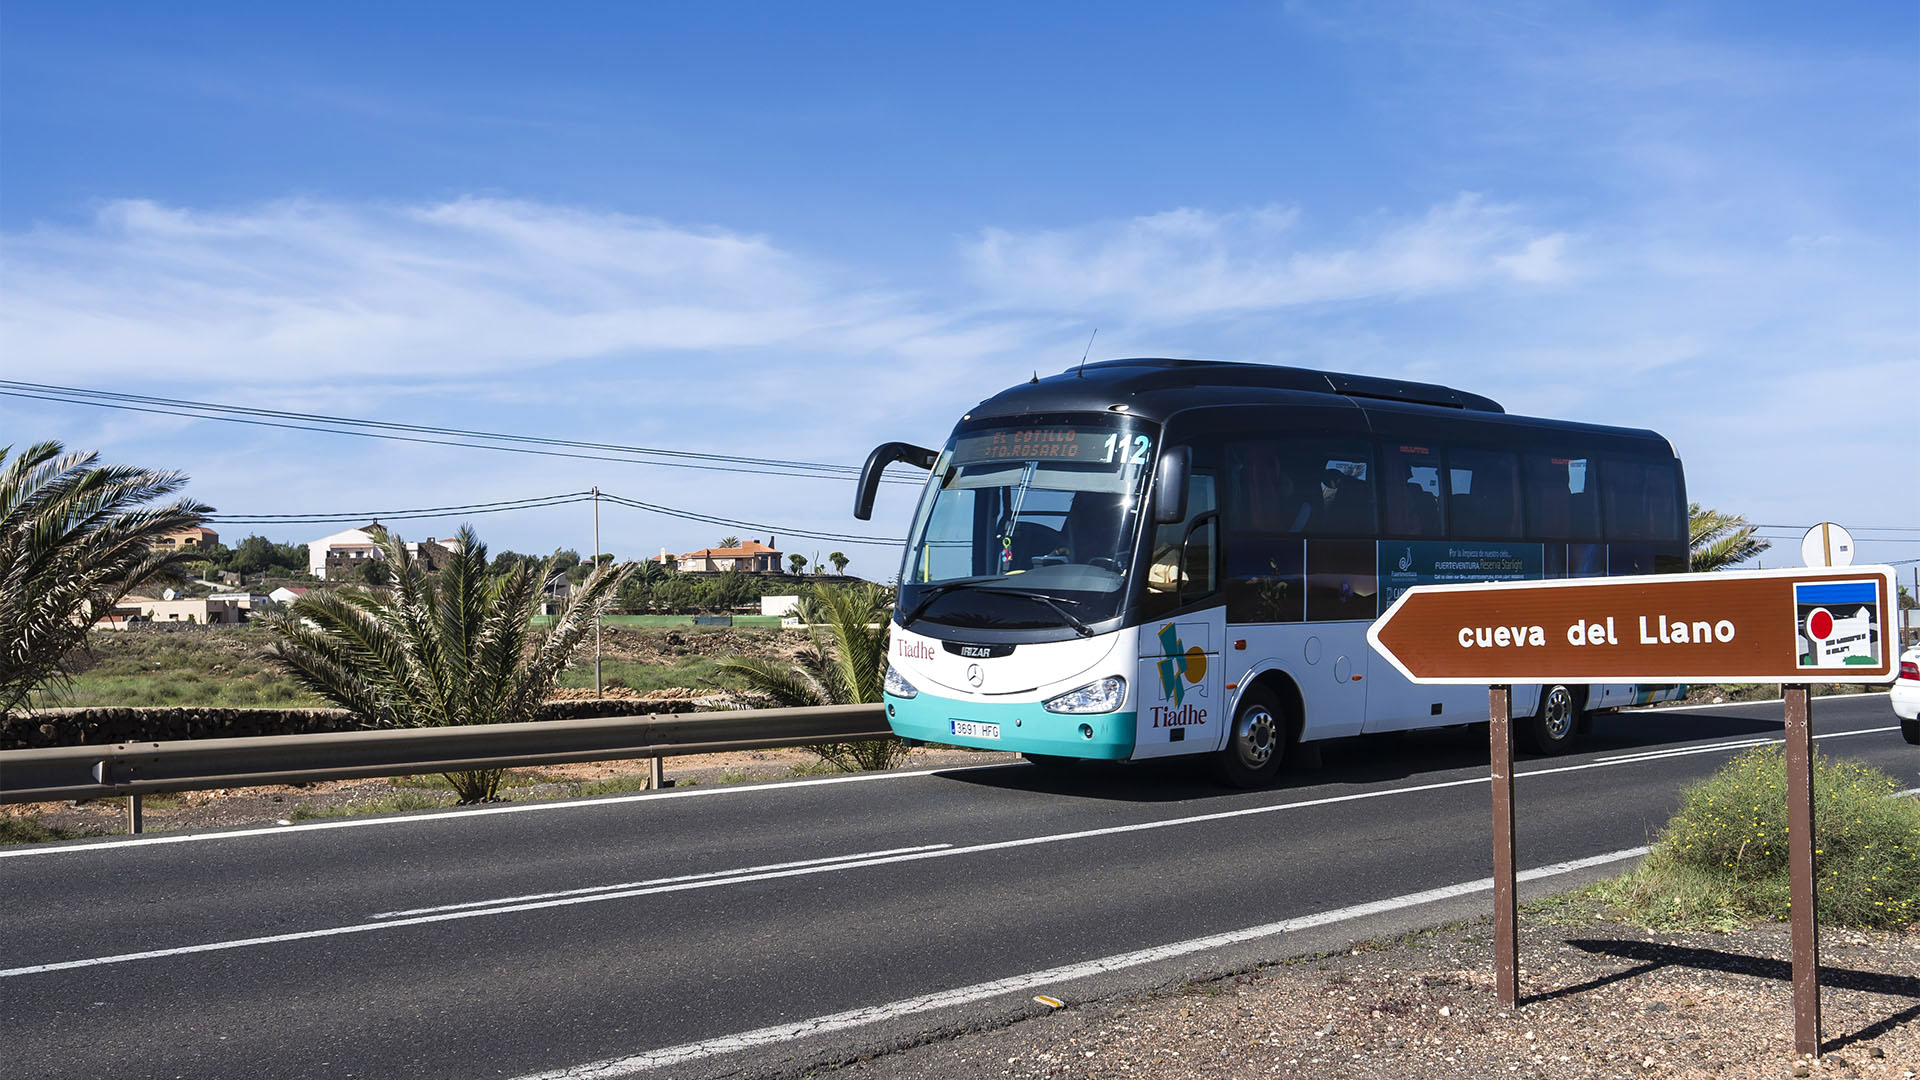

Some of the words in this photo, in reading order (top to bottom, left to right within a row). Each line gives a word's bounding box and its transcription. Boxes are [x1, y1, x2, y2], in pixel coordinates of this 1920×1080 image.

[993, 431, 1006, 444] EL
[1014, 429, 1076, 443] COTILLO
[1104, 433, 1149, 464] 112
[1458, 625, 1546, 648] cueva
[1567, 616, 1619, 646] del
[1639, 615, 1736, 645] Llano
[897, 639, 935, 660] Tiadhe
[961, 646, 990, 657] IRIZAR
[1150, 704, 1208, 728] Tiadhe
[957, 723, 977, 735] 3691
[982, 725, 999, 737] HFG
